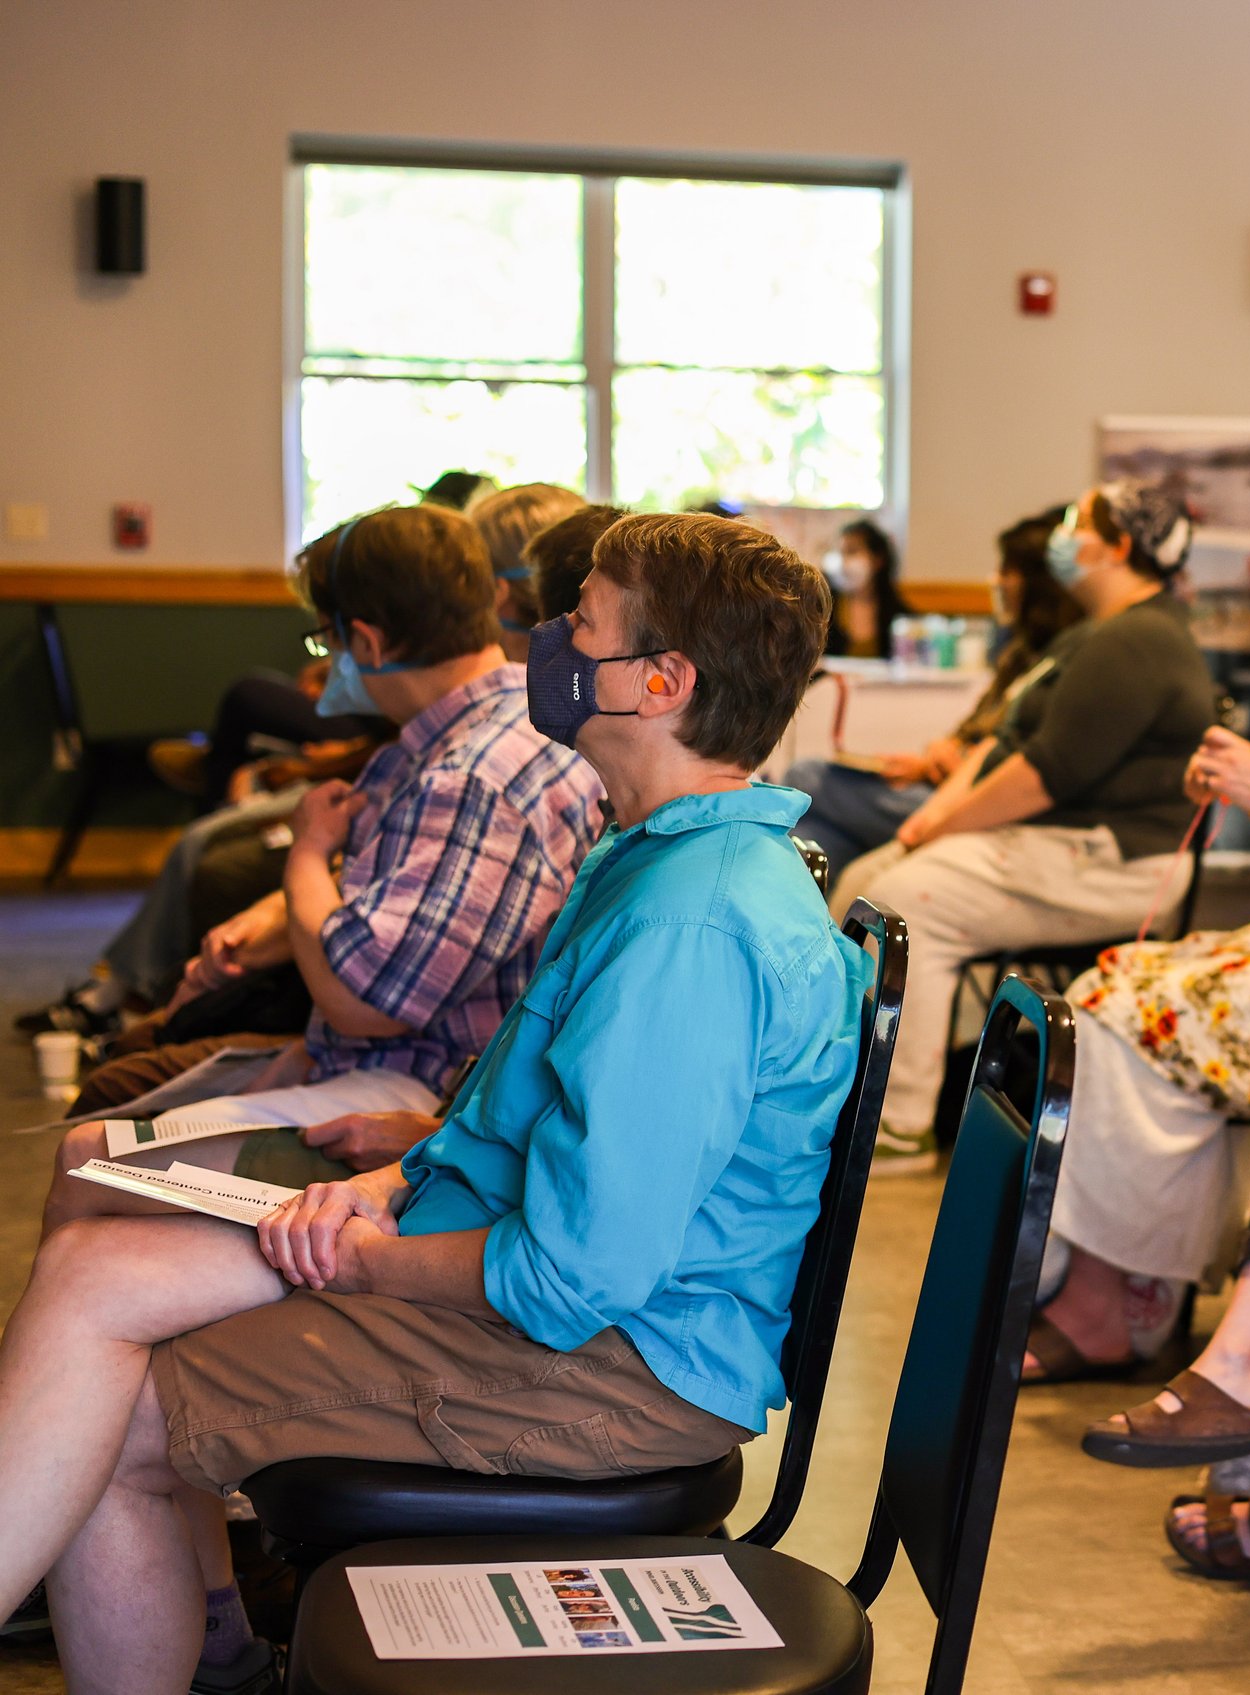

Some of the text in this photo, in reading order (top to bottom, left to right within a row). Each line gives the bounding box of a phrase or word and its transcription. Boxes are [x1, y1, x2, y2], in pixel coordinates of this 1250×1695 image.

[93, 1162, 143, 1178] Design
[147, 1176, 212, 1195] Centered
[217, 1192, 267, 1206] Human
[665, 1580, 690, 1606] Outdoors
[681, 1567, 711, 1602] Accessibility
